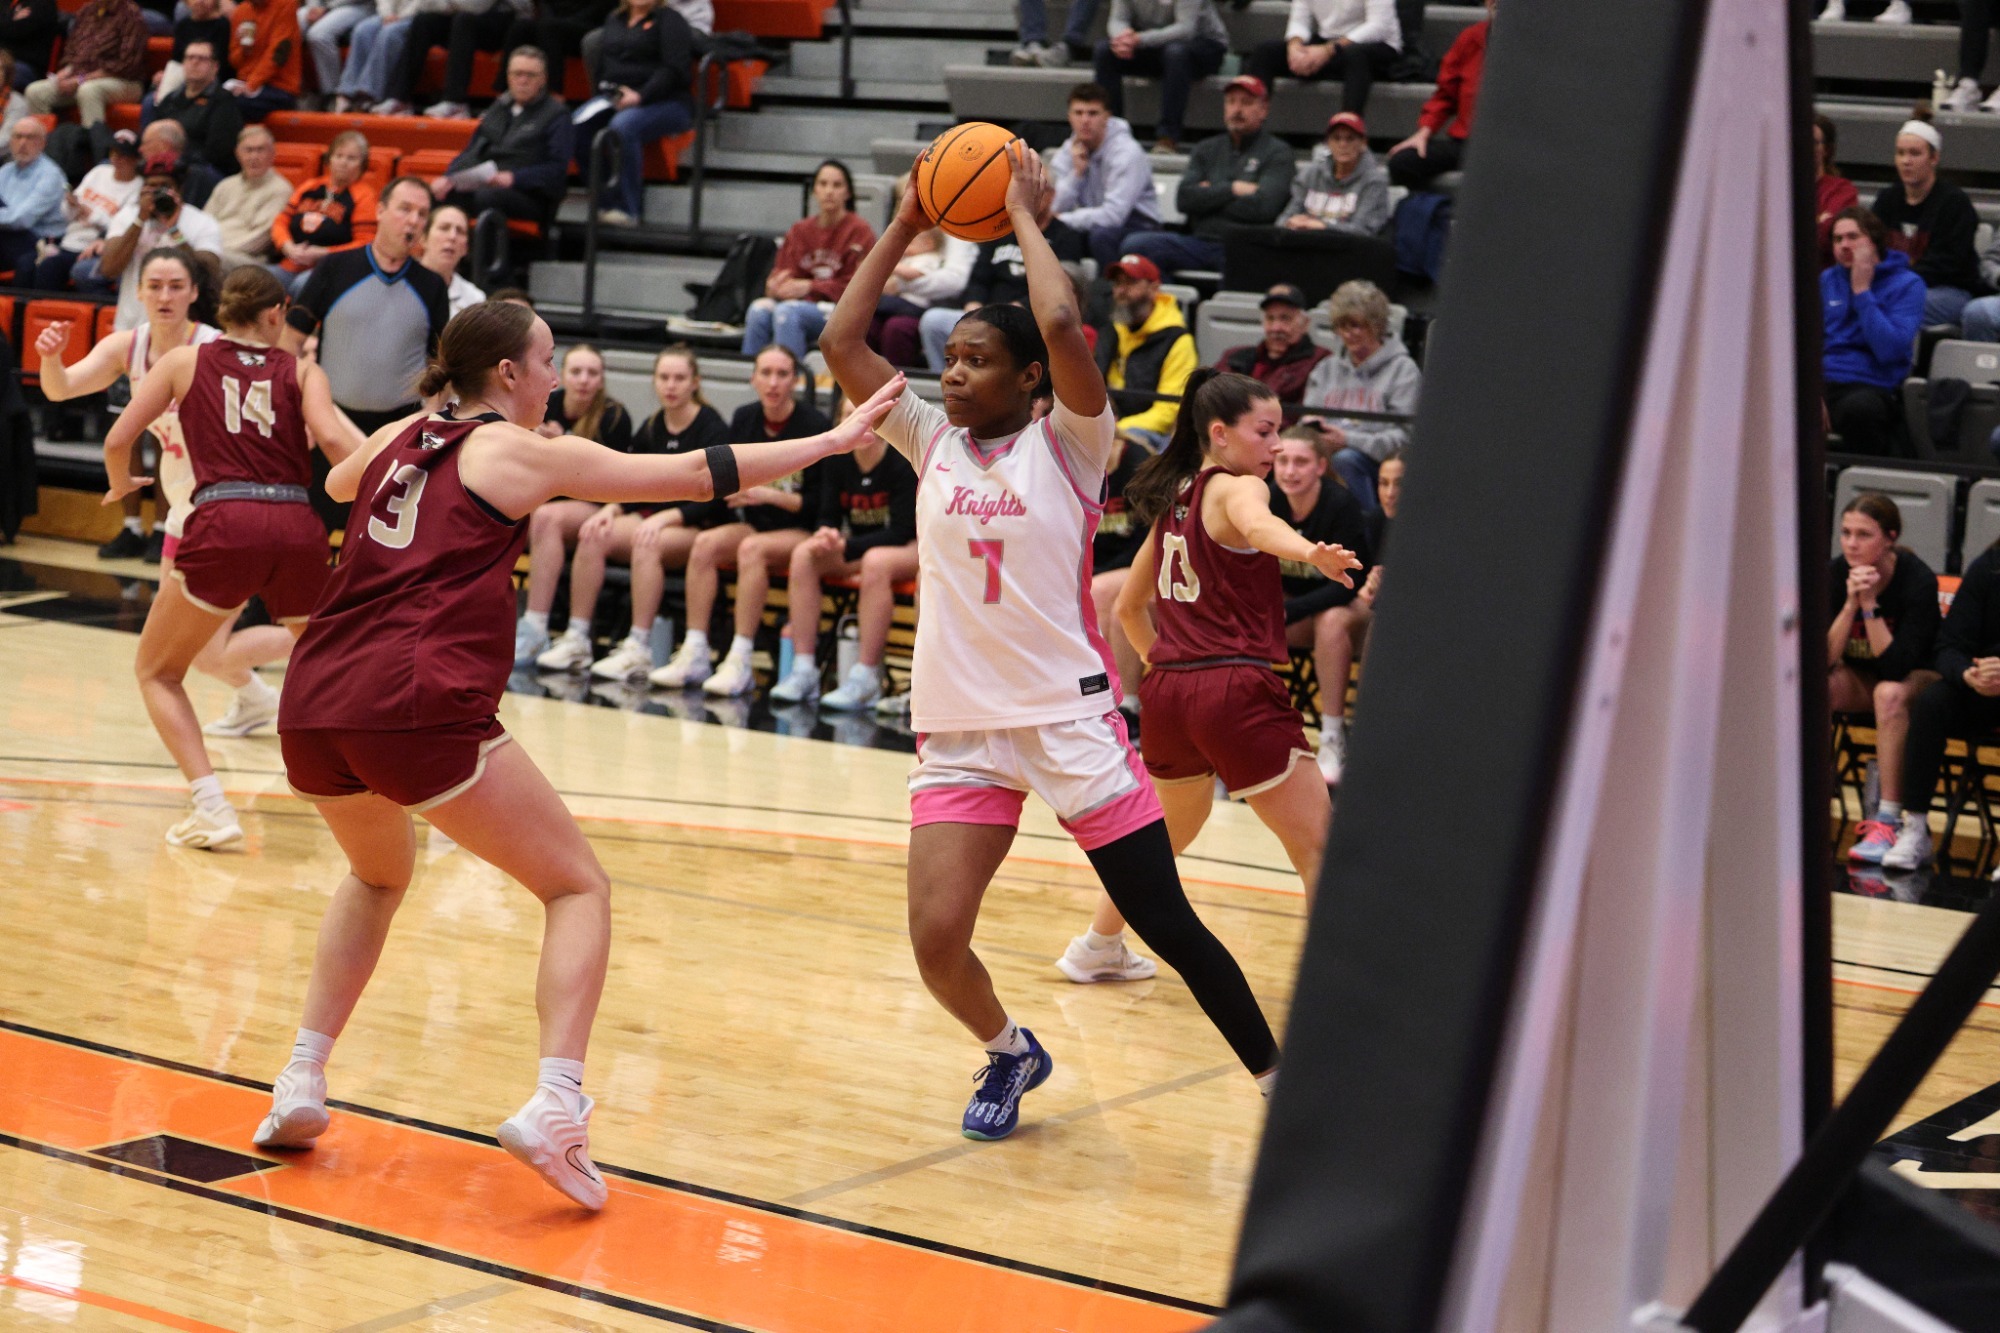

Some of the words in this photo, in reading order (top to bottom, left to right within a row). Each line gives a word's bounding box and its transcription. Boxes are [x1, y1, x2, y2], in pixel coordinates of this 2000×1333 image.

[222, 375, 276, 439] 14
[359, 459, 428, 549] 3
[945, 485, 1027, 526] Knights
[967, 538, 1005, 605] 7
